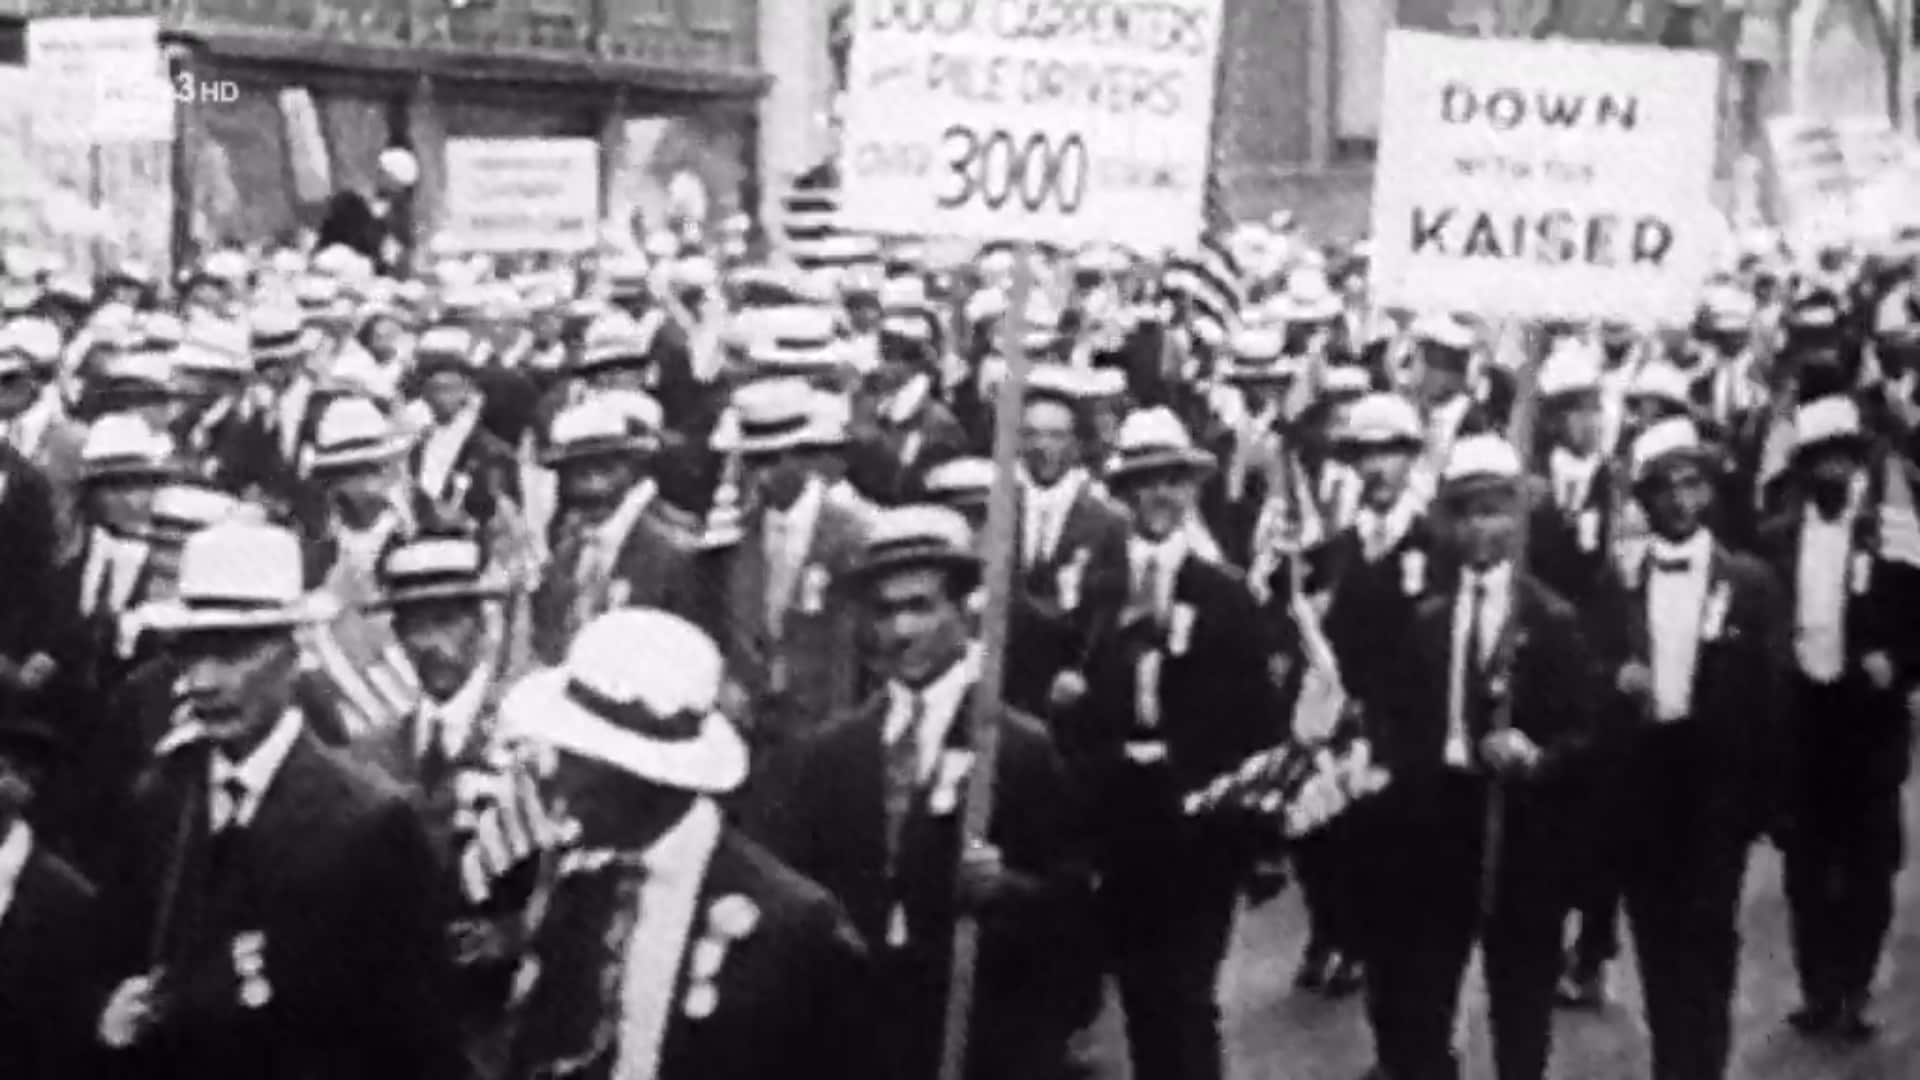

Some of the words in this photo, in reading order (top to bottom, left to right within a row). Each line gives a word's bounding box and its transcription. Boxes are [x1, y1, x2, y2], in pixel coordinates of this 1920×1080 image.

[1440, 82, 1638, 131] DOWN
[936, 124, 1088, 214] 3000
[1409, 204, 1675, 266] KAISER
